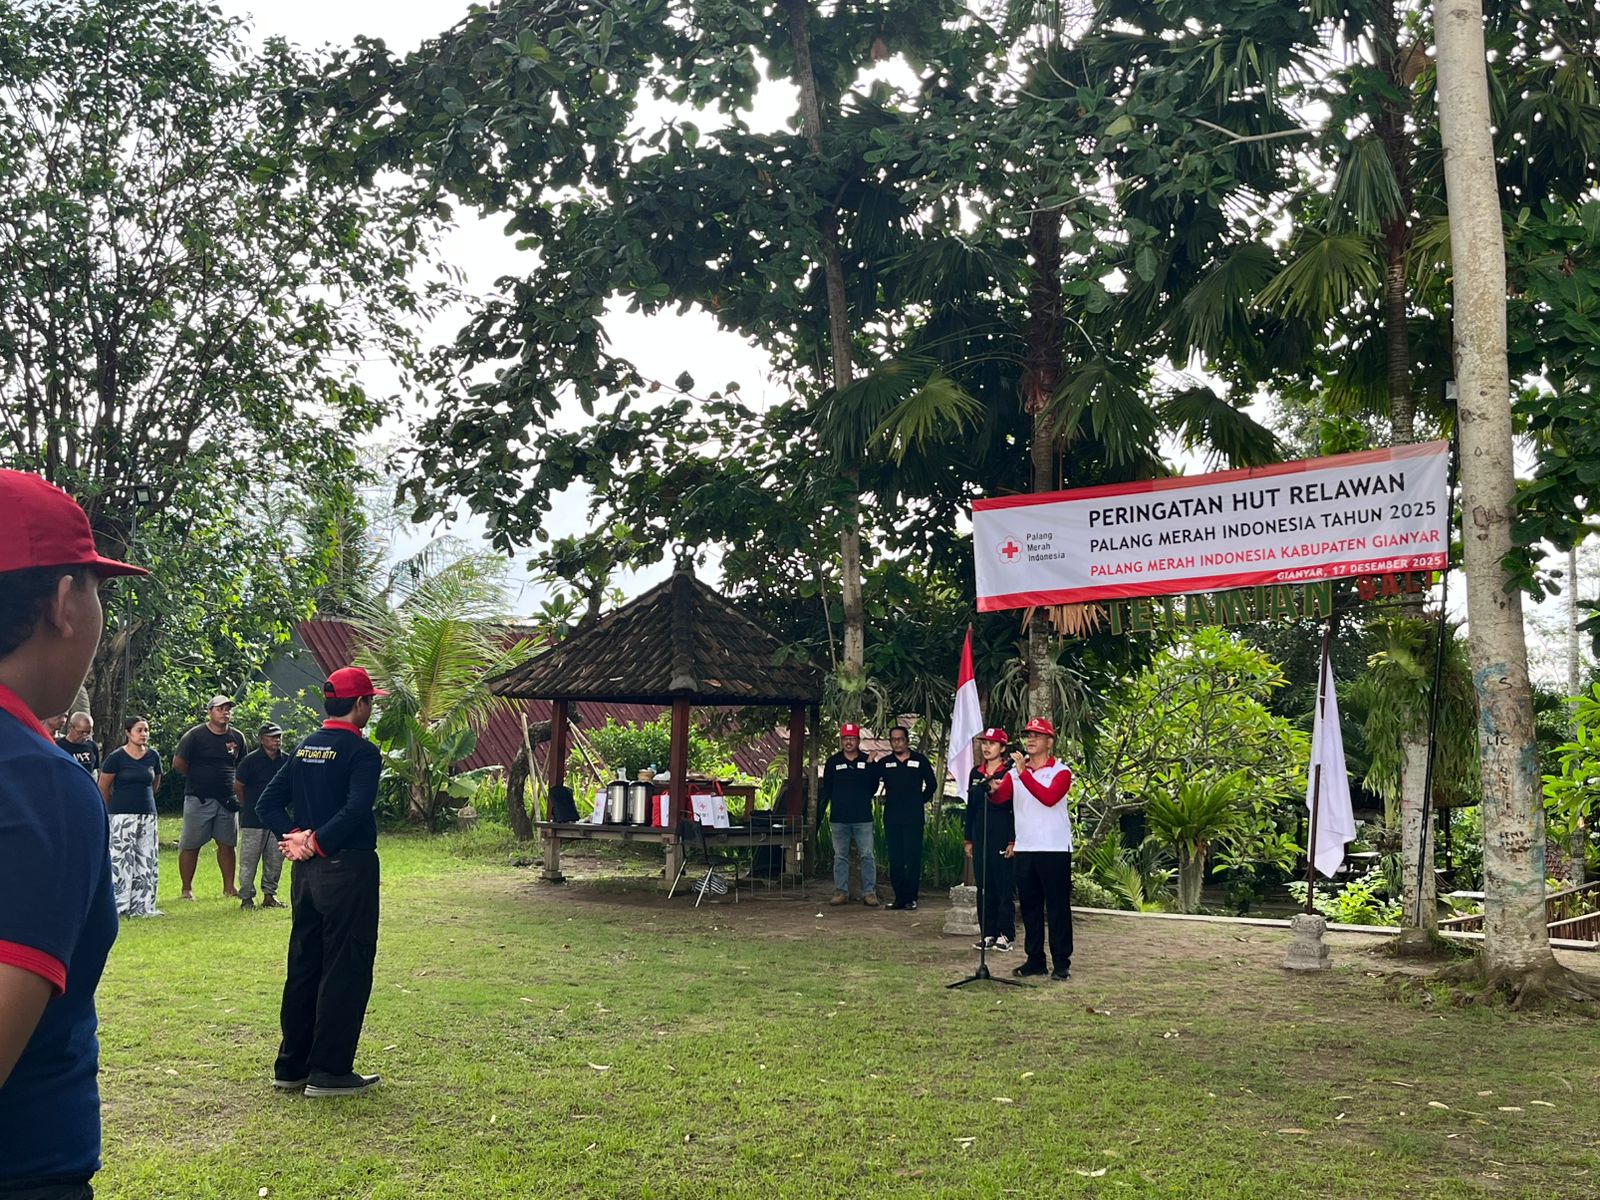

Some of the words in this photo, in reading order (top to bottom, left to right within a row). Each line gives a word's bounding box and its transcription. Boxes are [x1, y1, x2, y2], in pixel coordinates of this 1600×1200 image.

[1089, 495, 1223, 528] PERINGATAN
[1233, 488, 1280, 511] HUT
[1290, 472, 1405, 505] RELAWAN
[1090, 533, 1153, 552] PALANG
[1158, 526, 1216, 546] MERAH
[1223, 516, 1316, 539] INDONESIA
[1321, 507, 1382, 528] TAHUN
[1390, 501, 1436, 520] 2025
[1026, 532, 1053, 541] Palang
[1027, 543, 1051, 552] Merah
[1090, 561, 1143, 576] PALANG
[1147, 556, 1195, 572] MERAH
[1200, 548, 1275, 567] INDONESIA
[1281, 537, 1366, 558] KABUPATEN
[1372, 530, 1440, 549] GIANYAR
[1028, 552, 1065, 562] Indonesia
[1276, 567, 1328, 580] GIANYAR,
[1332, 565, 1346, 576] 17
[1350, 559, 1408, 573] DESEMBER
[1412, 556, 1441, 567] 2025
[296, 749, 322, 759] SATUAN
